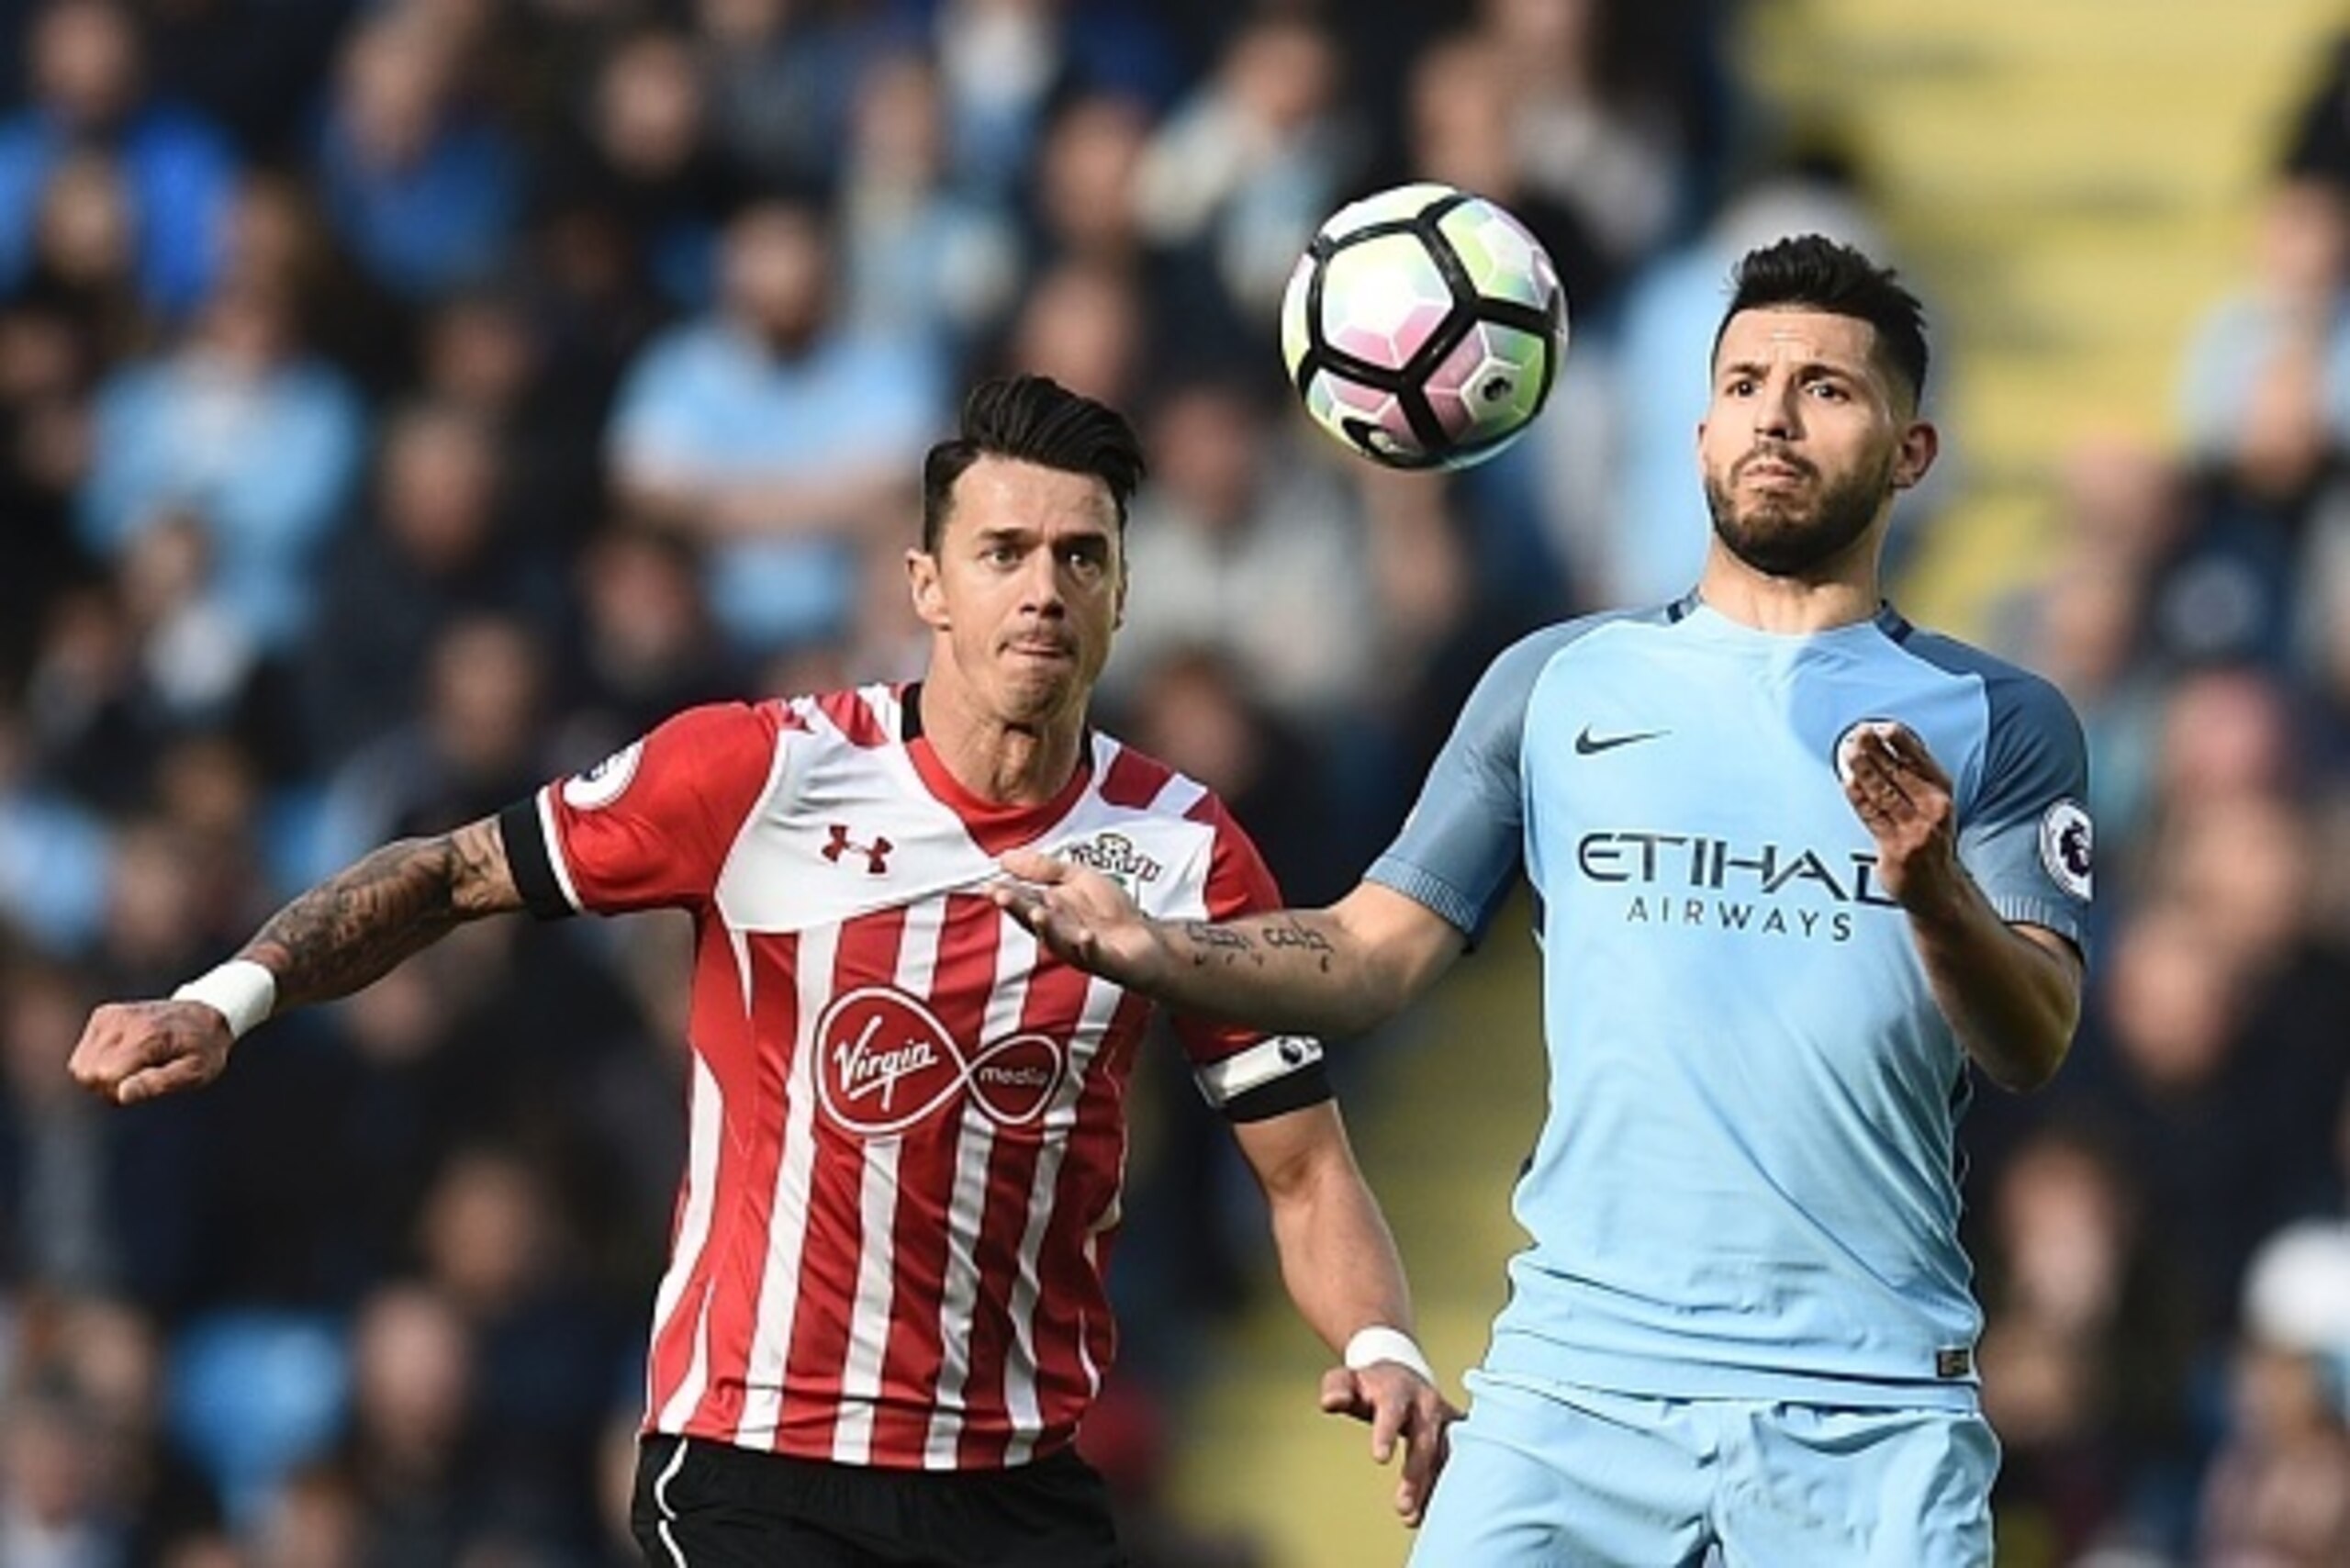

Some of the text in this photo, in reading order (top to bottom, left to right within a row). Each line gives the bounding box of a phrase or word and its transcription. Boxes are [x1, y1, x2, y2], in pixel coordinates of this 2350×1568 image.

[1627, 896, 1852, 942] AIRWAYS
[833, 1014, 1048, 1113] Virgin media
